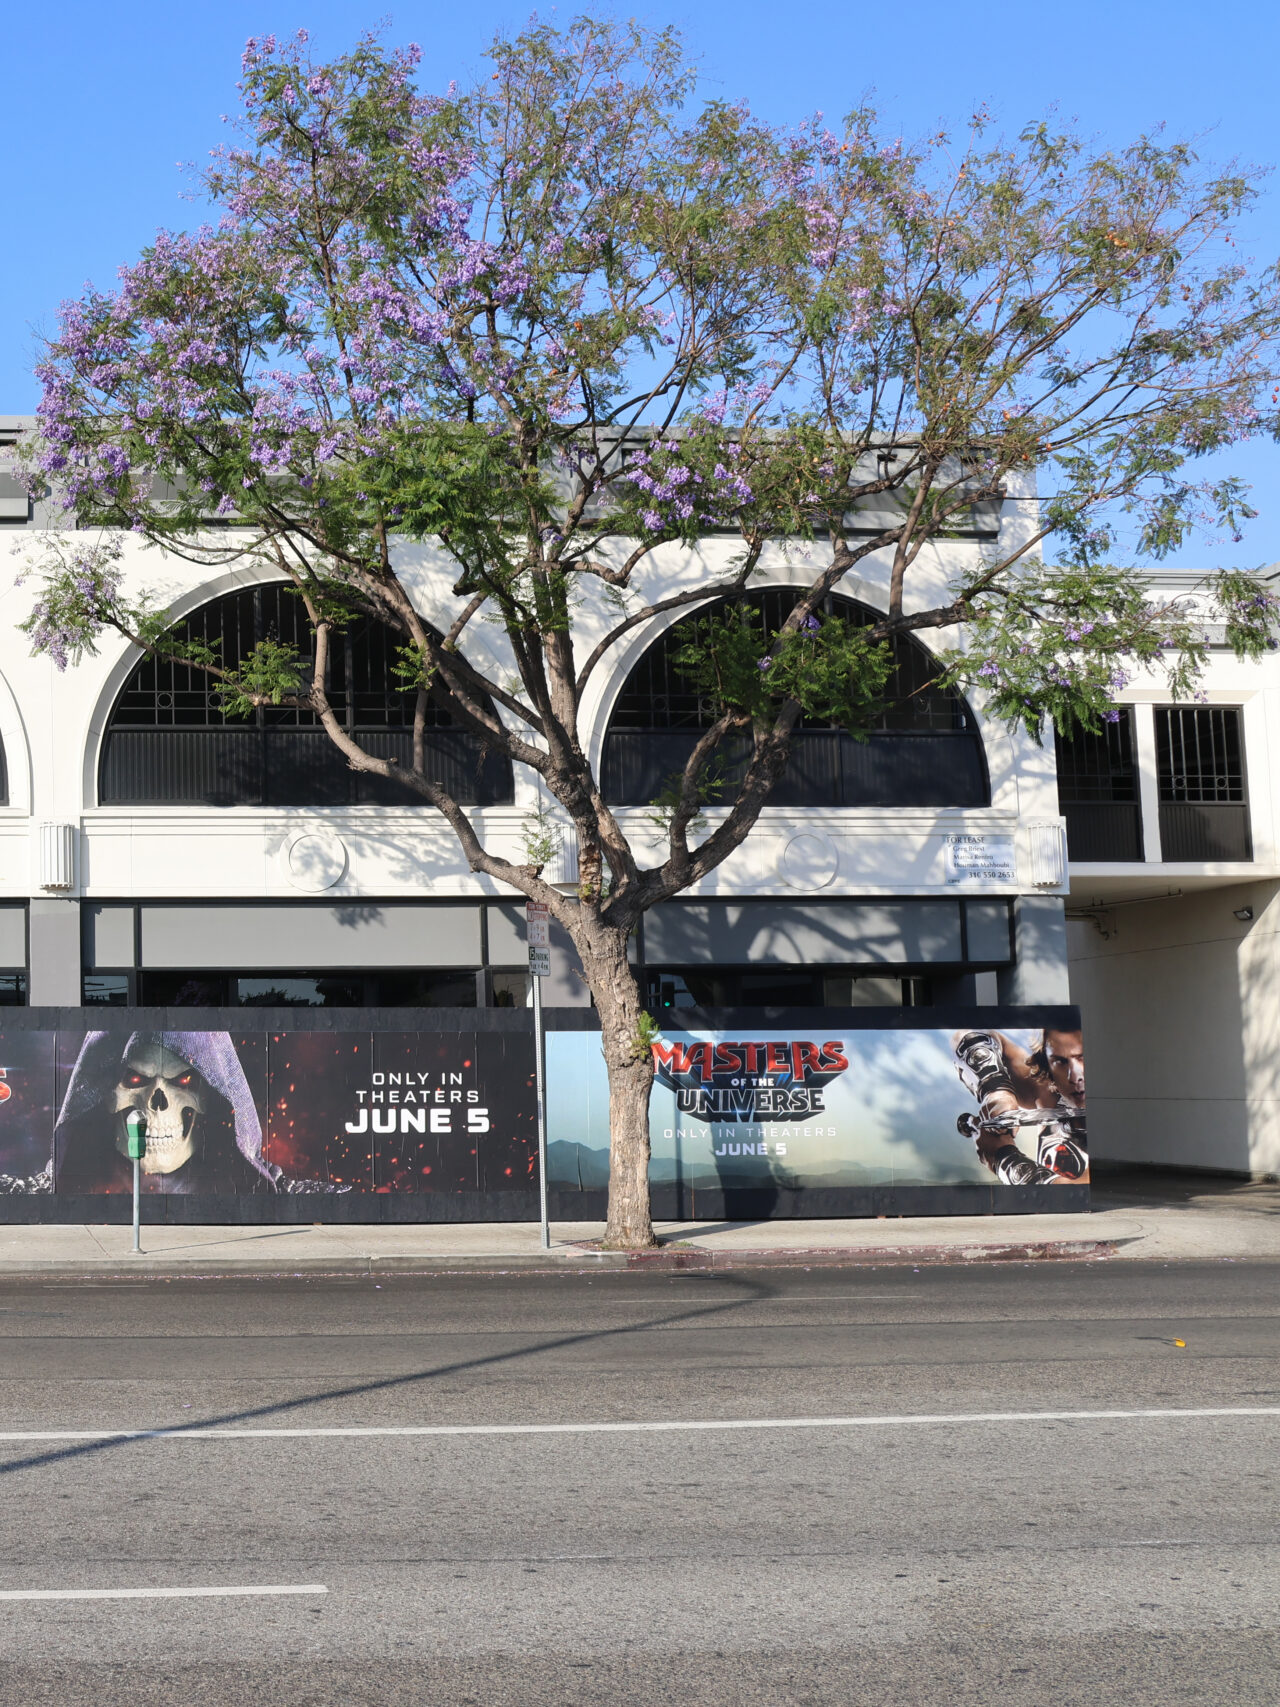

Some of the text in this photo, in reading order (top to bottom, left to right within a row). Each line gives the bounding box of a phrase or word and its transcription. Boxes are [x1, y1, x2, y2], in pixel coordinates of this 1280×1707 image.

[946, 836, 985, 844] FOR LEASE
[651, 1041, 850, 1083] MASTERS
[372, 1072, 463, 1086] ONLY IN
[730, 1078, 775, 1087] OF THE
[355, 1090, 479, 1104] THEATERS
[676, 1087, 826, 1113] UNIVERSE
[344, 1108, 490, 1134] JUNE 5
[663, 1127, 837, 1139] ONLY IN THEATERS
[715, 1142, 787, 1156] JUNE 5
